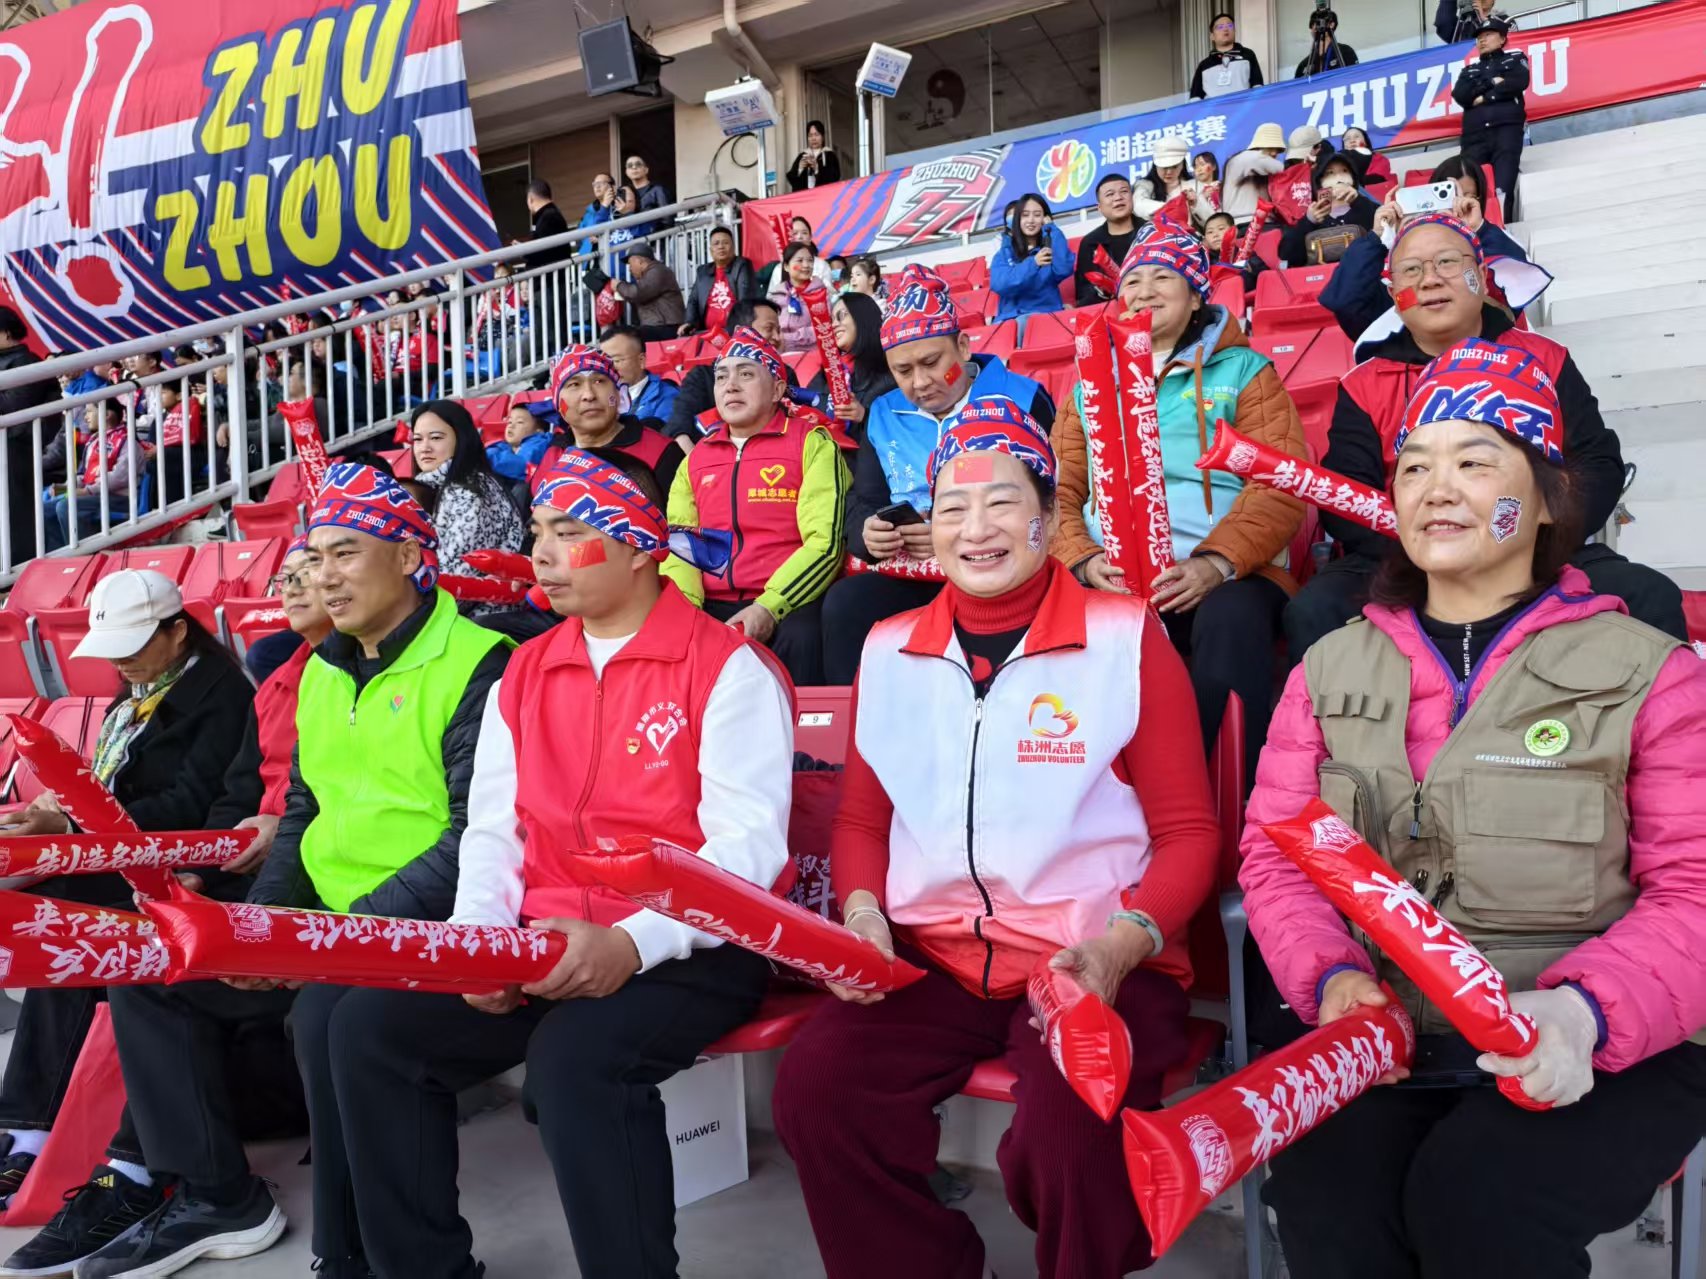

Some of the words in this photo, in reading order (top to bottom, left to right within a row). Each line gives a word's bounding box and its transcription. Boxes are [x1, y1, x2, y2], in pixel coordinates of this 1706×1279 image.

[201, 0, 406, 155] ZHU
[1100, 115, 1227, 167] 湘超联赛
[916, 161, 981, 182] ZHUZHOU
[154, 134, 412, 291] ZHOU
[1017, 739, 1086, 754] 株洲志愿
[1017, 755, 1046, 763] ZHUZHOU
[1048, 755, 1086, 764] VOLUNTEER
[676, 1119, 721, 1146] HUAWEI
